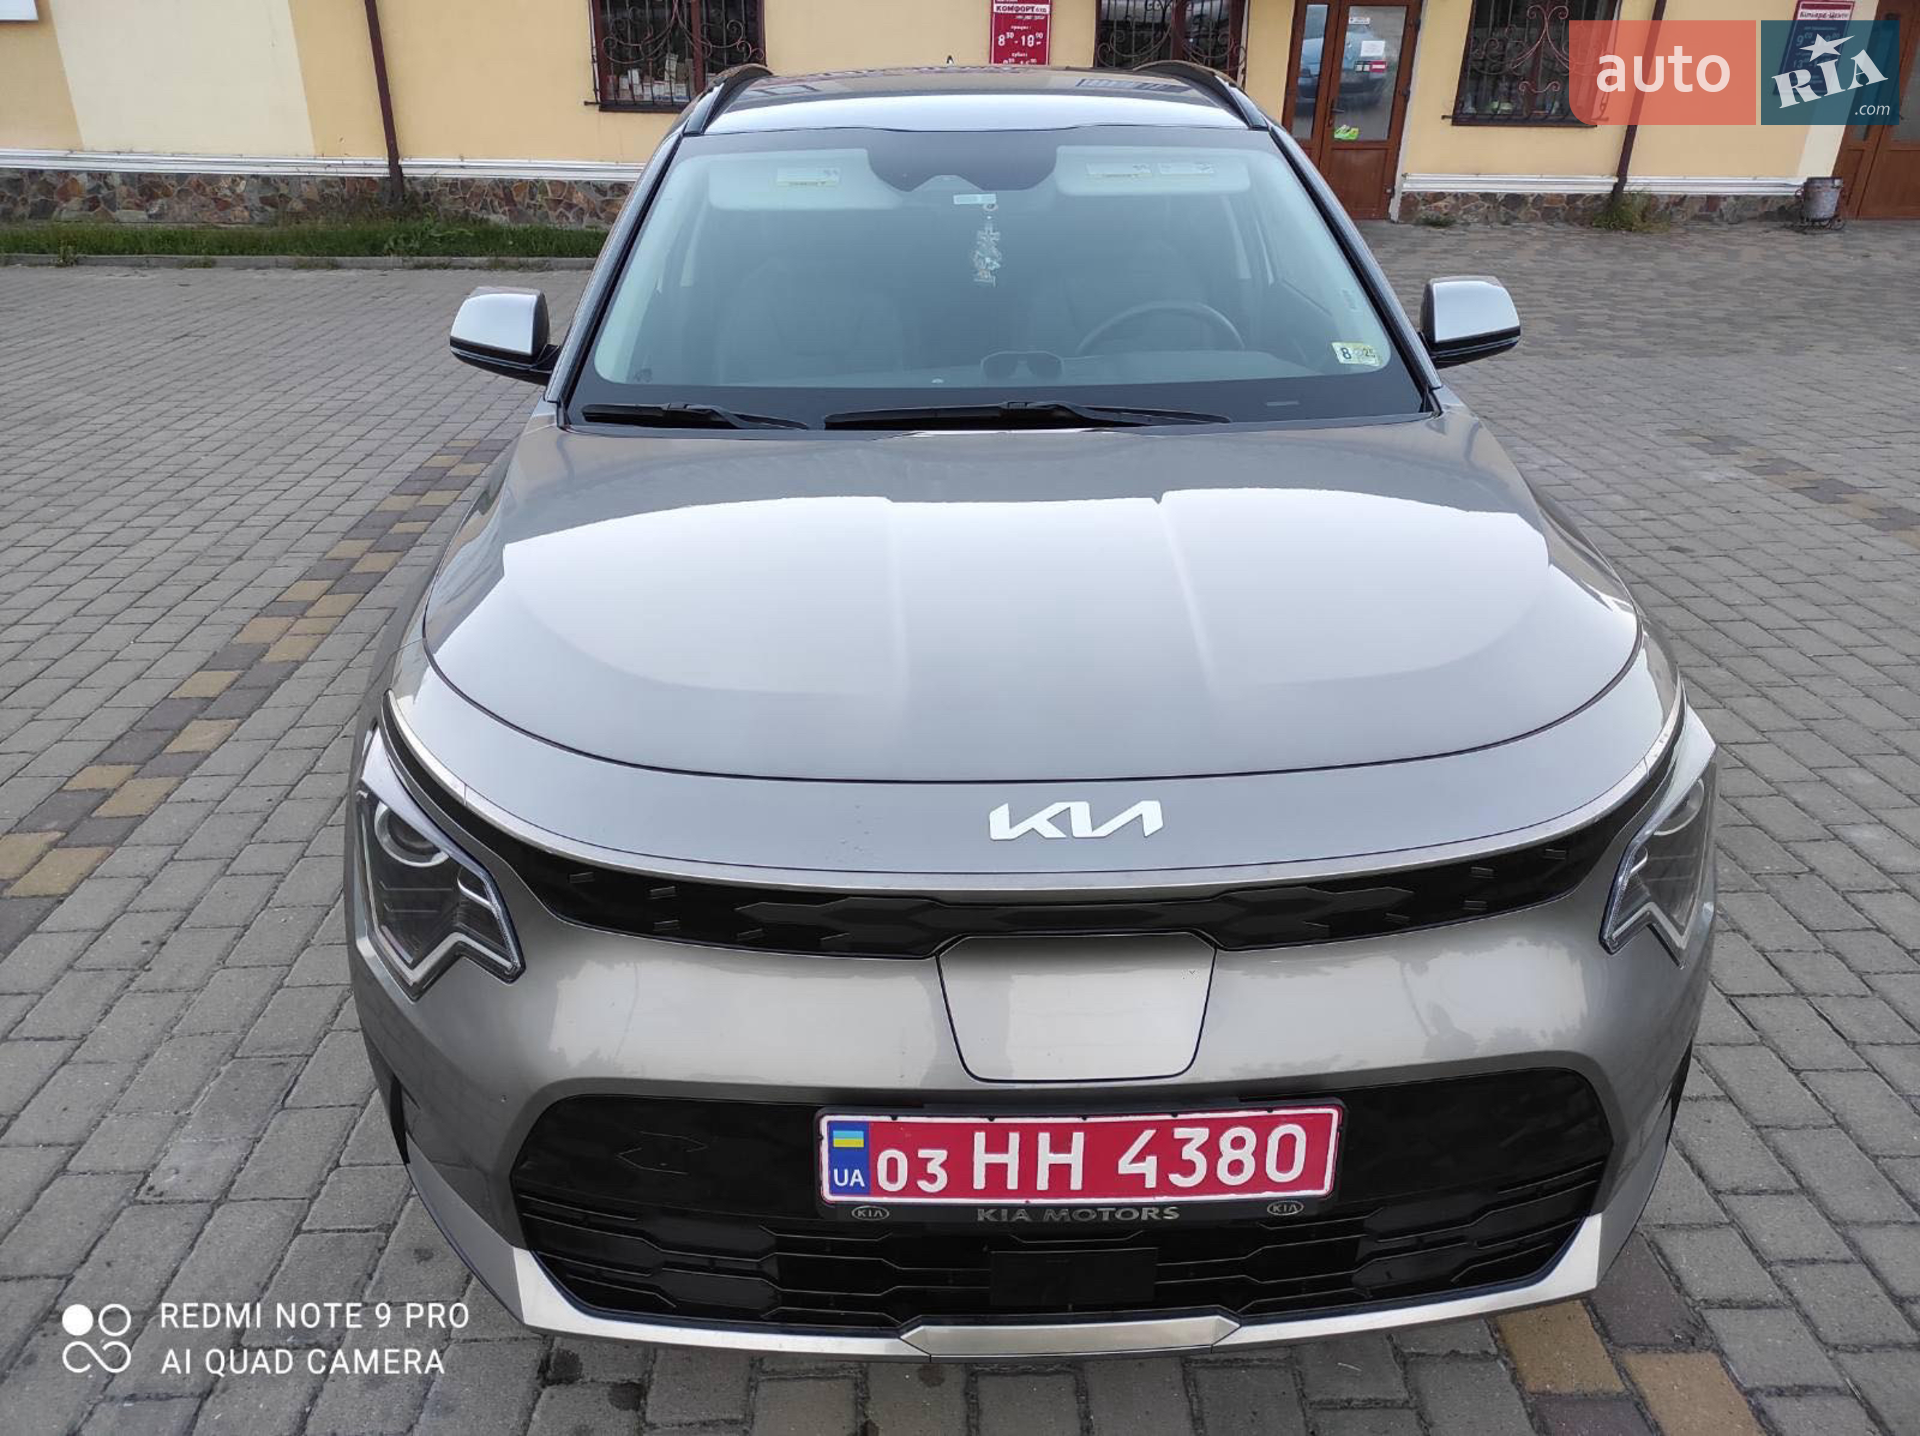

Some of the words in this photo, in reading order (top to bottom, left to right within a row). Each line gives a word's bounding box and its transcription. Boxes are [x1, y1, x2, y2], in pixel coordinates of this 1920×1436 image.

[996, 5, 1035, 13] КОМФОРТ
[876, 1149, 949, 1194] 03
[1117, 1123, 1308, 1189] 4380
[833, 1168, 866, 1188] UA
[977, 1208, 1032, 1222] KIA
[1042, 1206, 1180, 1222] MOTORS
